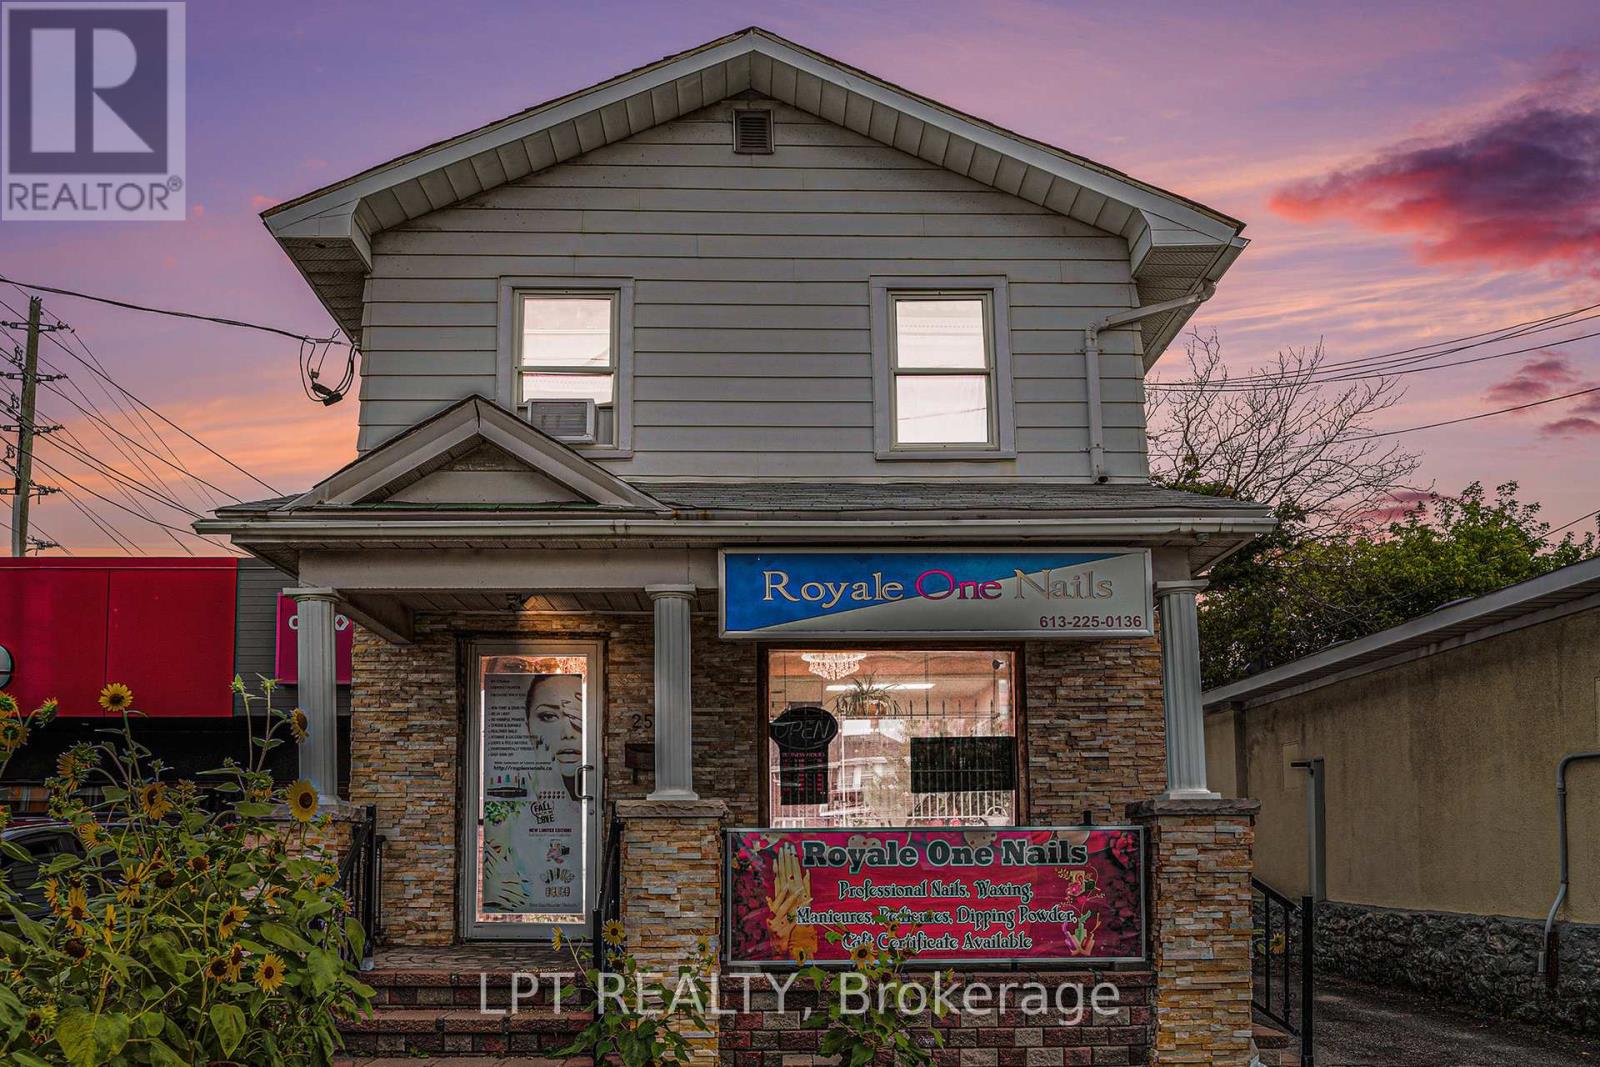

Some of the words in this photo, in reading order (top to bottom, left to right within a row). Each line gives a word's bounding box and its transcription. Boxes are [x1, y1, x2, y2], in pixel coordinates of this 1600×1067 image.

[762, 570, 904, 609] Royale
[915, 569, 1002, 600] One
[1014, 569, 1113, 600] Nails
[1039, 615, 1142, 628] 613-225-0136
[632, 713, 653, 729] 25
[802, 839, 918, 874] Royale
[927, 839, 993, 866] One
[1001, 839, 1088, 866] Nails
[838, 879, 927, 900] Professional
[956, 905, 1016, 931] Dipping
[962, 931, 1033, 950] Available
